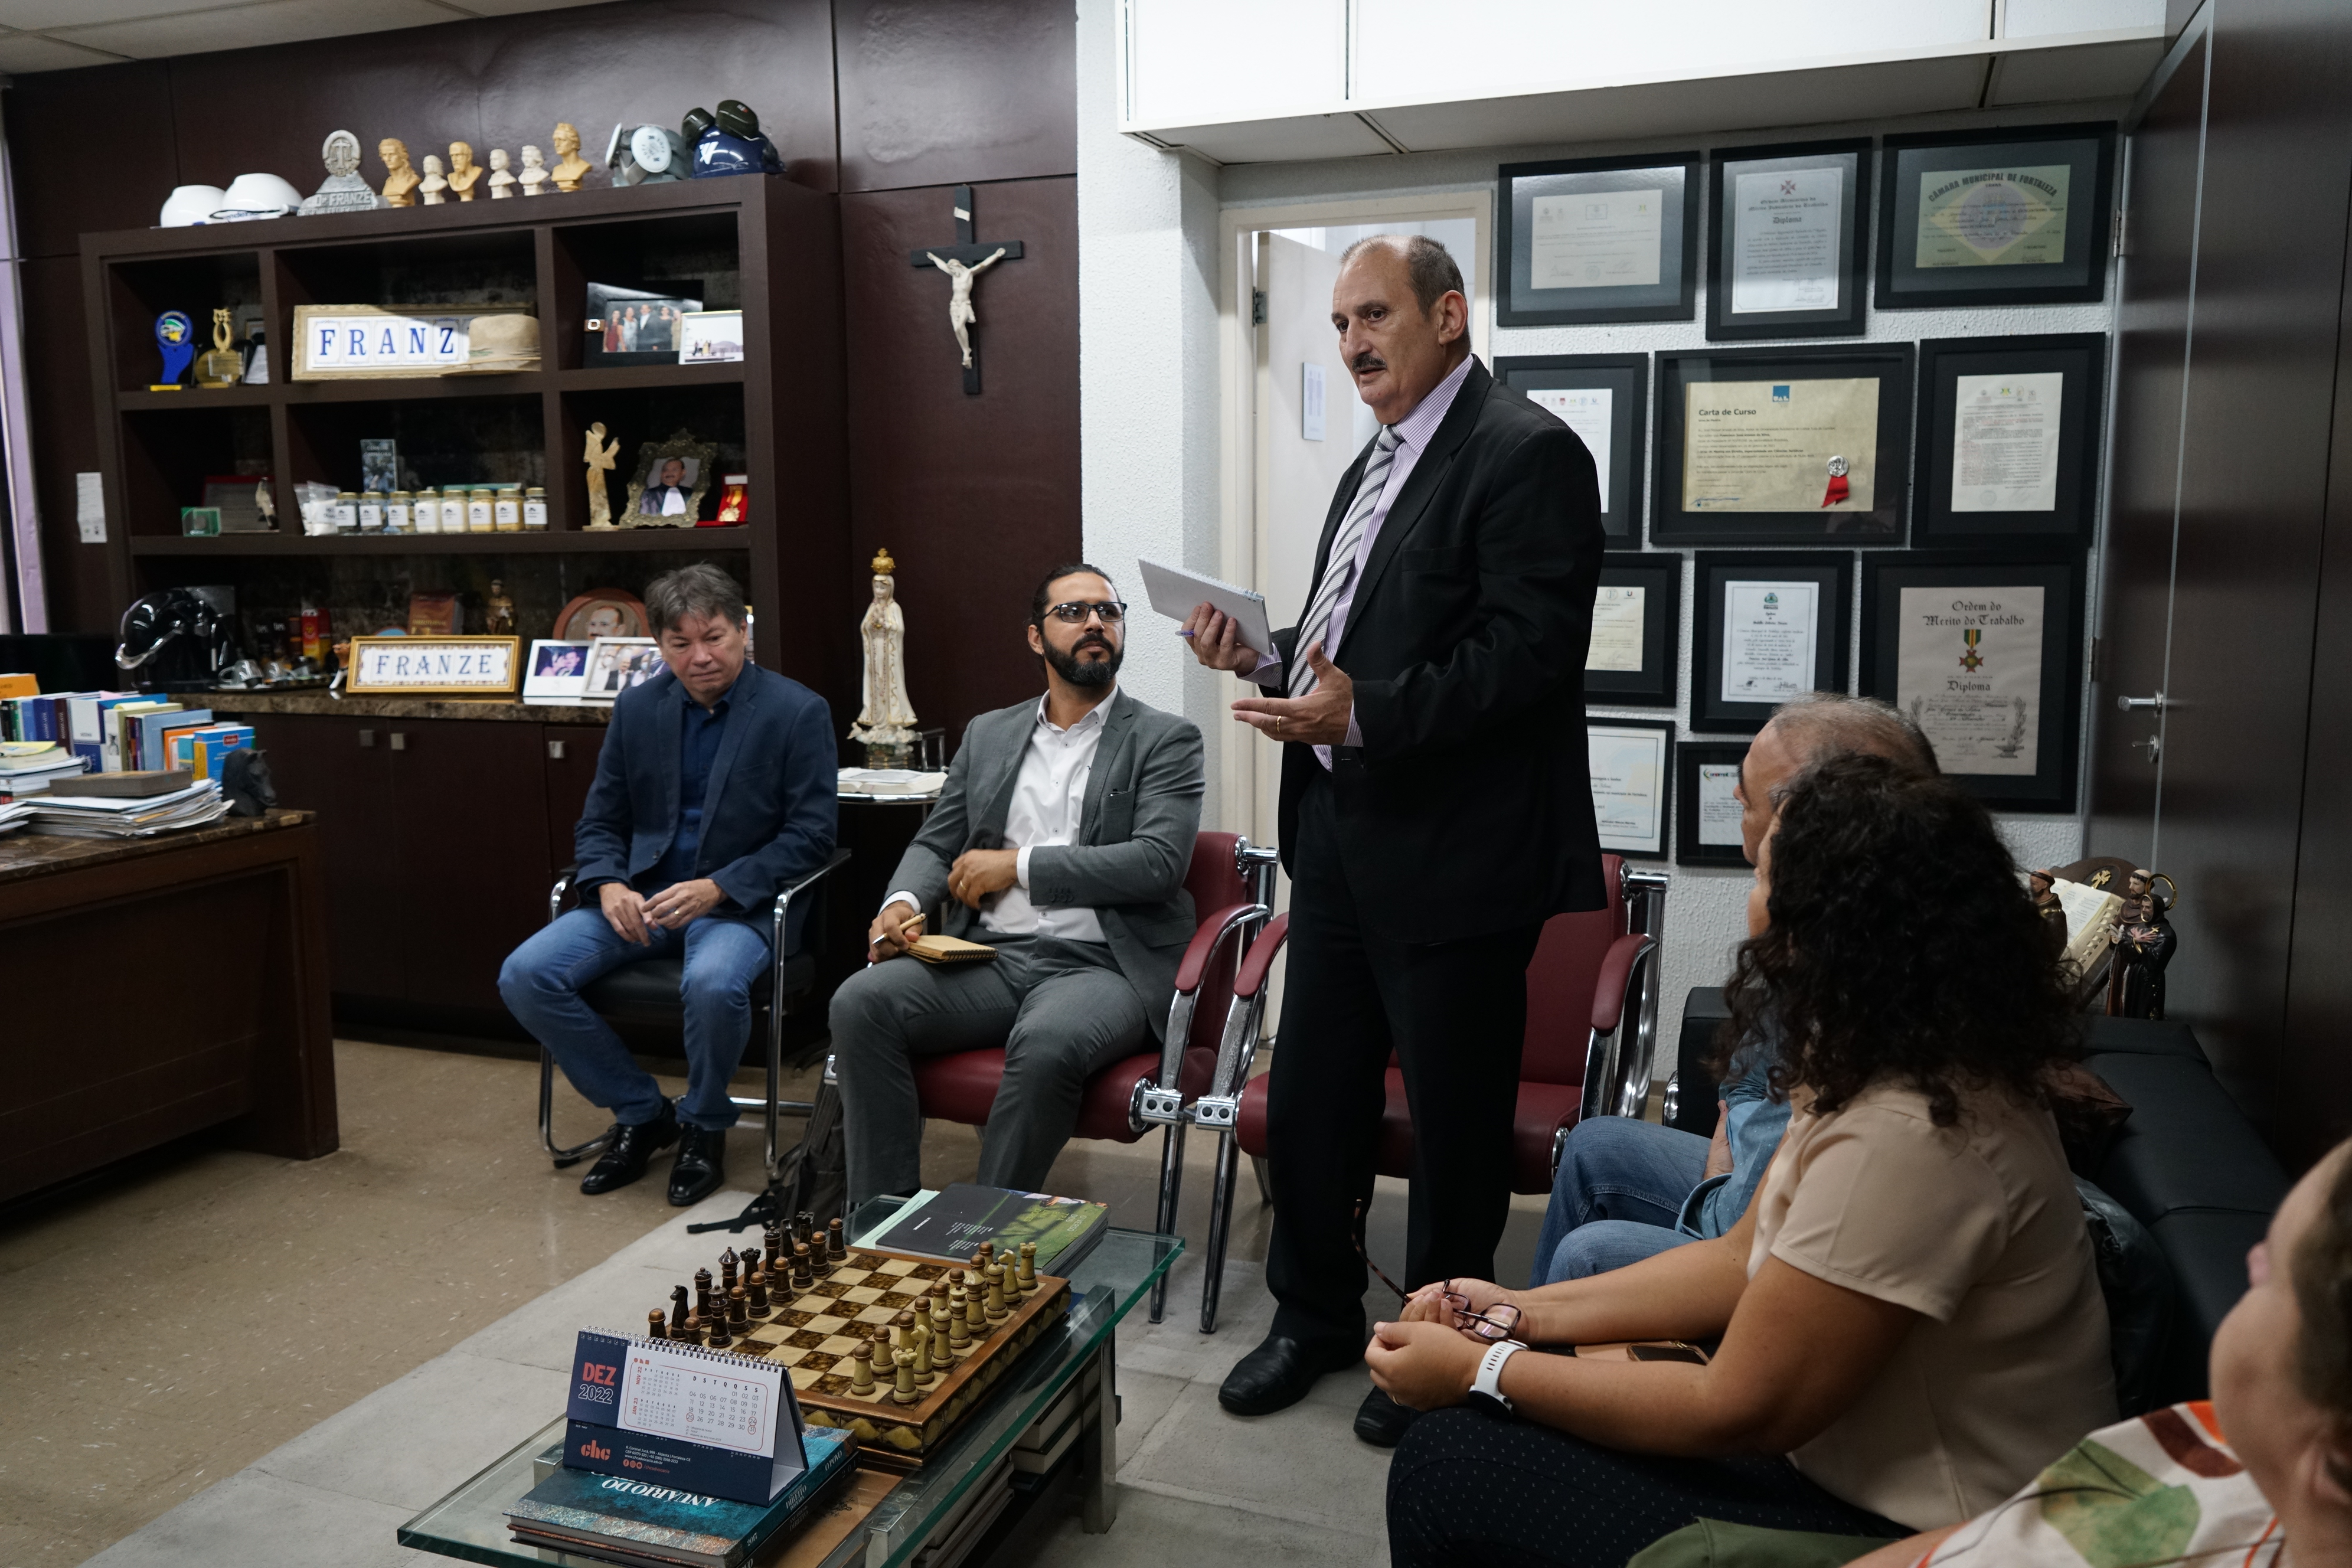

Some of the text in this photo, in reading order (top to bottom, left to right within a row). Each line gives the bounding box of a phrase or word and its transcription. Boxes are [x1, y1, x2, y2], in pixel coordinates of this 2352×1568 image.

[1962, 173, 2004, 185] MUNICIPAL
[2007, 172, 2017, 182] DE
[2020, 175, 2058, 197] FORTALEZA
[329, 191, 371, 206] FRANZE
[1772, 217, 1802, 225] Diploma
[319, 327, 470, 356] FRANZ
[1952, 600, 2001, 612] Ordem do
[1964, 615, 1975, 626] do
[1978, 613, 2025, 626] Trabalho
[376, 654, 492, 676] FRANZE
[1947, 680, 1991, 693] Diploma
[583, 1362, 616, 1386] DEZ
[578, 1384, 613, 1404] 2022
[581, 1439, 611, 1461] chc
[625, 1454, 663, 1465] www.chcadvocacia.adv.br
[602, 1479, 634, 1492] DO
[631, 1484, 721, 1508] ANUÁRIO
[786, 1485, 806, 1509] DIREITO
[789, 1510, 808, 1531] DIREITO
[747, 1532, 757, 1546] 2017
